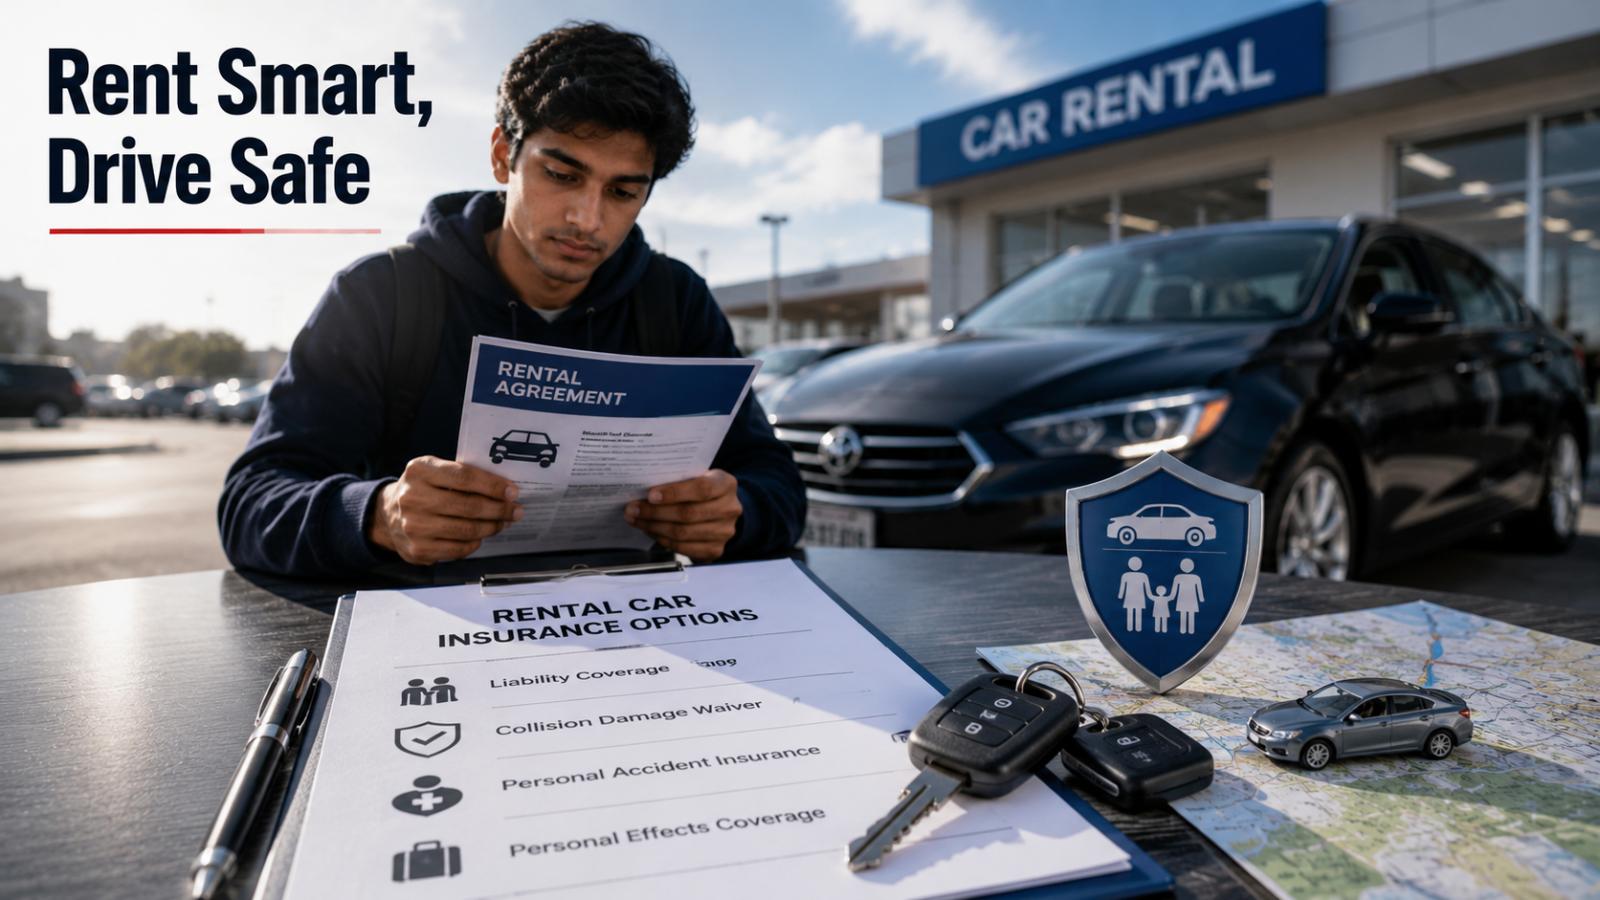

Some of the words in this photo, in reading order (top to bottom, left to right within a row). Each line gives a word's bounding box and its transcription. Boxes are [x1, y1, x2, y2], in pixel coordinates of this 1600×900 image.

[961, 99, 1050, 163] CAR
[1061, 38, 1275, 138] RENTAL
[498, 360, 582, 386] RENTAL
[494, 381, 627, 406] AGREEMENT
[438, 620, 624, 648] INSURANCE
[629, 608, 759, 631] OPTIONS
[493, 601, 623, 624] RENTAL
[628, 594, 697, 613] CAR
[490, 673, 570, 689] Liability
[575, 662, 671, 680] Coverage
[495, 716, 592, 736] Collision
[599, 706, 689, 727] Damage
[691, 698, 764, 716] Waiver
[501, 767, 606, 791] Personal
[612, 757, 712, 779] Accident
[715, 744, 822, 767] Insurance
[509, 829, 621, 858] Personal
[626, 820, 711, 844] Effects
[715, 806, 826, 832] Coverage
